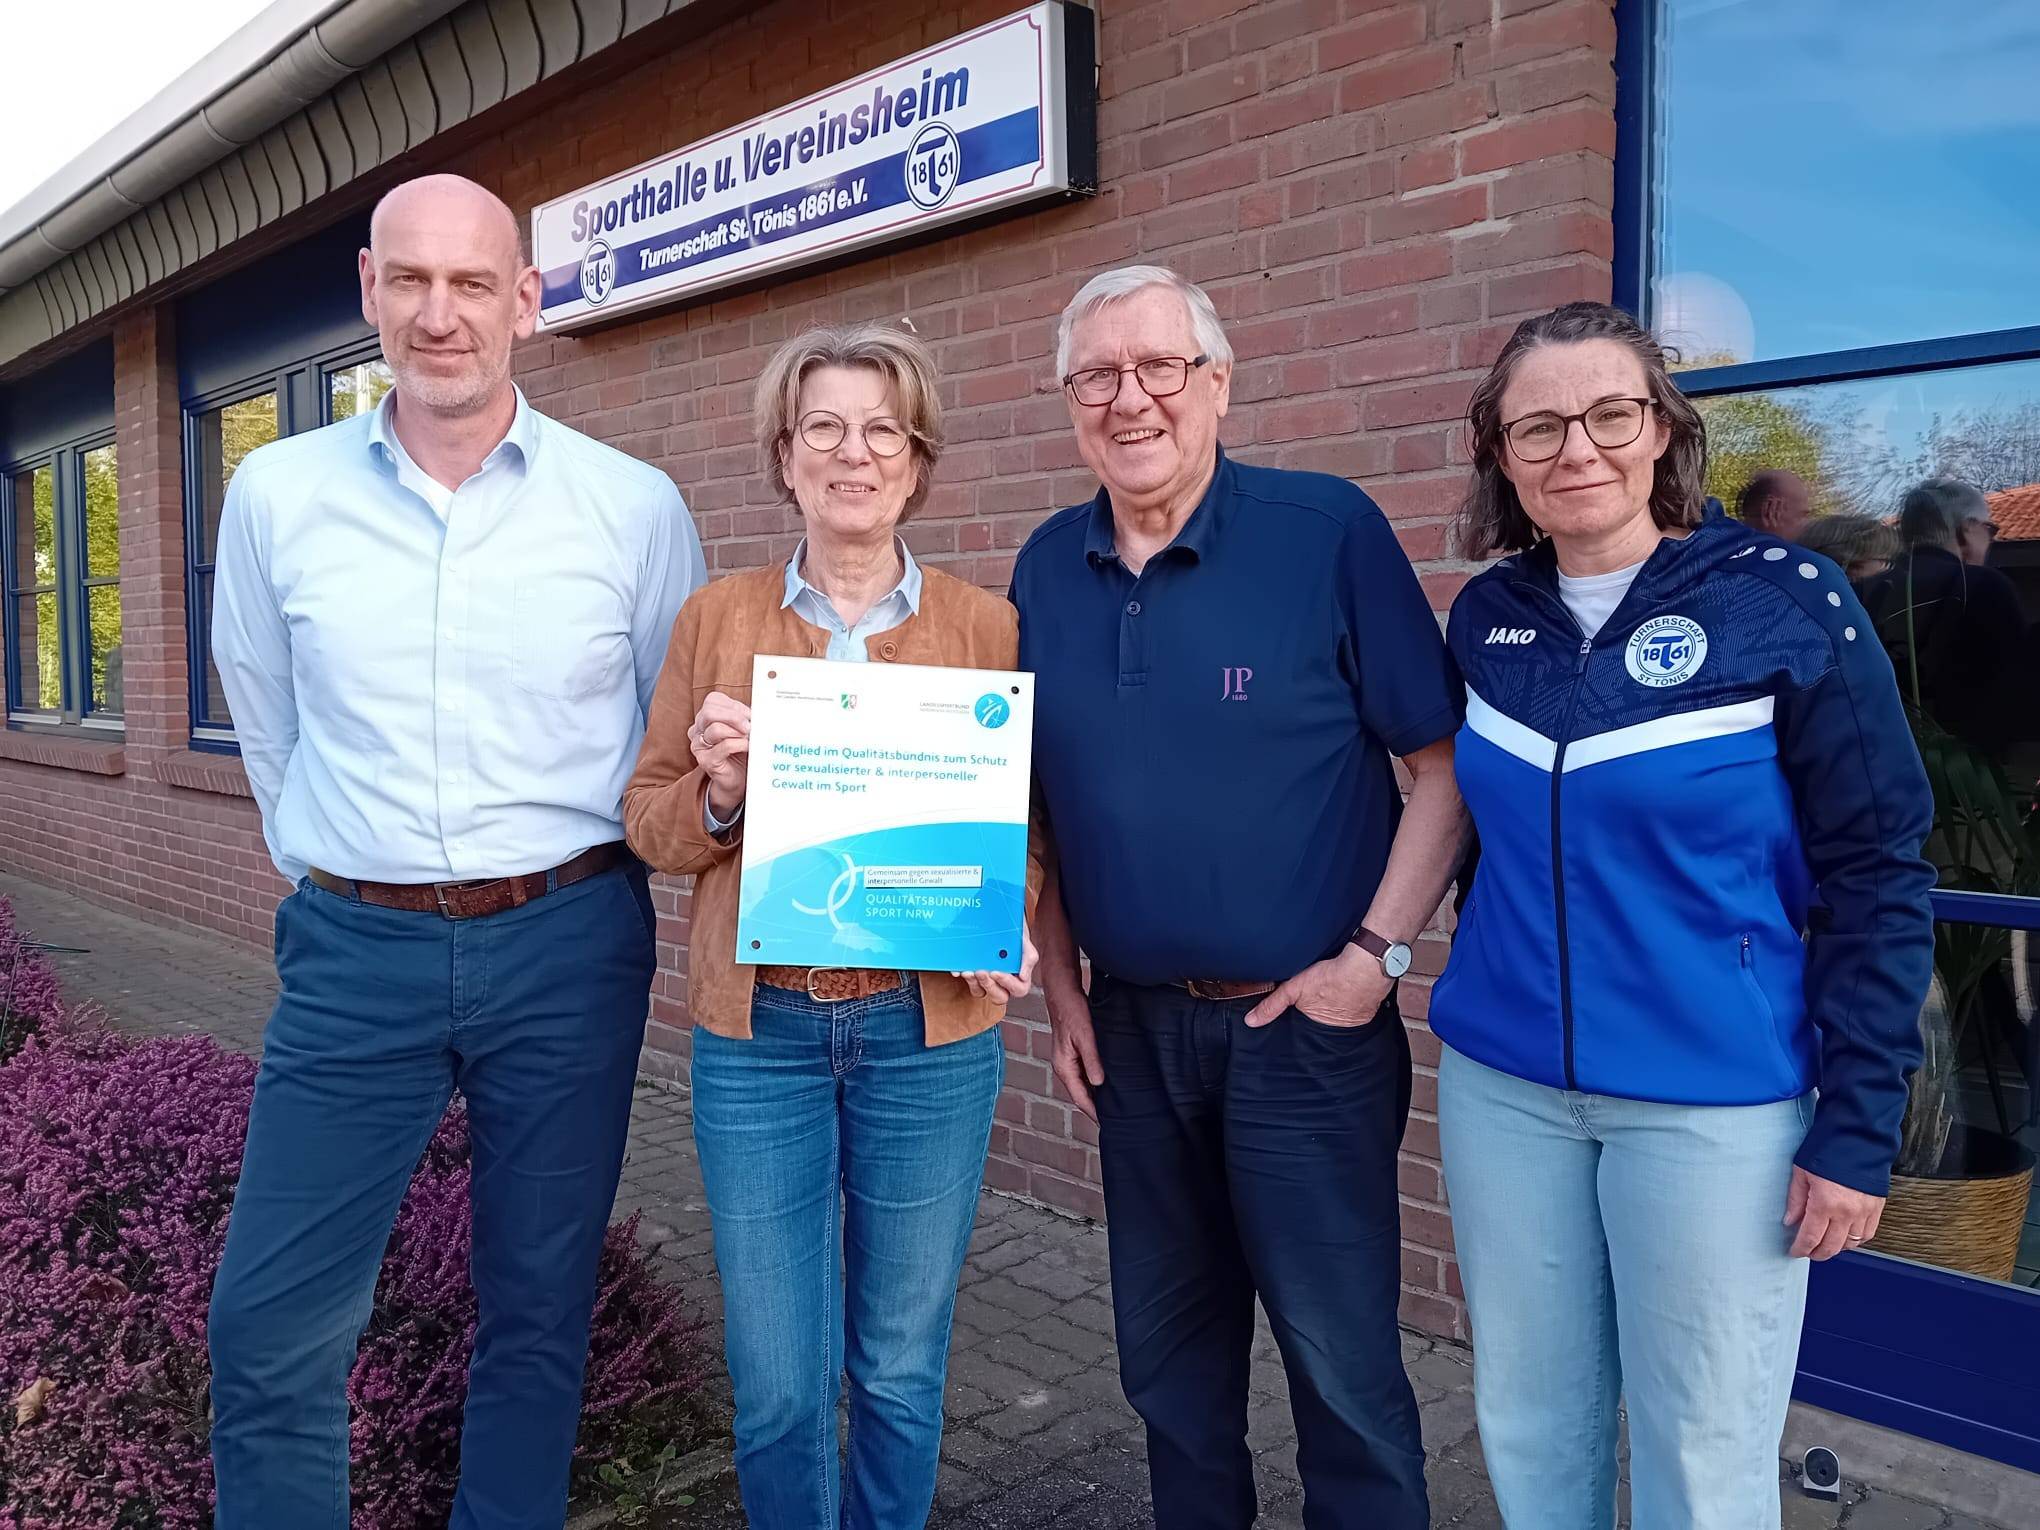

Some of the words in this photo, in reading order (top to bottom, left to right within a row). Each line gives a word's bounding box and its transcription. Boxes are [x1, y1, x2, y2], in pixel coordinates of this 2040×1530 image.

[571, 162, 707, 243] Sporthalle
[714, 156, 736, 193] u.
[743, 67, 969, 183] Vereinsheim
[639, 223, 729, 271] Turnerschaft
[729, 218, 749, 243] St.
[752, 204, 797, 236] Tönis
[799, 188, 837, 222] 1861
[837, 178, 868, 210] e.V.
[1484, 627, 1537, 644] JAKO
[1630, 617, 1705, 648] TURNERSCHAFT
[1220, 667, 1253, 701] JP
[1637, 673, 1651, 684] ST
[773, 743, 821, 758] Mitglied
[824, 748, 839, 757] im
[943, 755, 967, 764] zum
[970, 754, 1008, 766] Schutz
[773, 763, 791, 772] vor
[794, 764, 872, 776] sexualisierter
[875, 767, 884, 777] &
[888, 769, 979, 782] interpersoneller
[771, 778, 814, 791] Gewalt
[816, 781, 831, 791] im
[835, 782, 867, 795] Sport
[865, 907, 903, 918] SPORT
[905, 908, 935, 919] NRW
